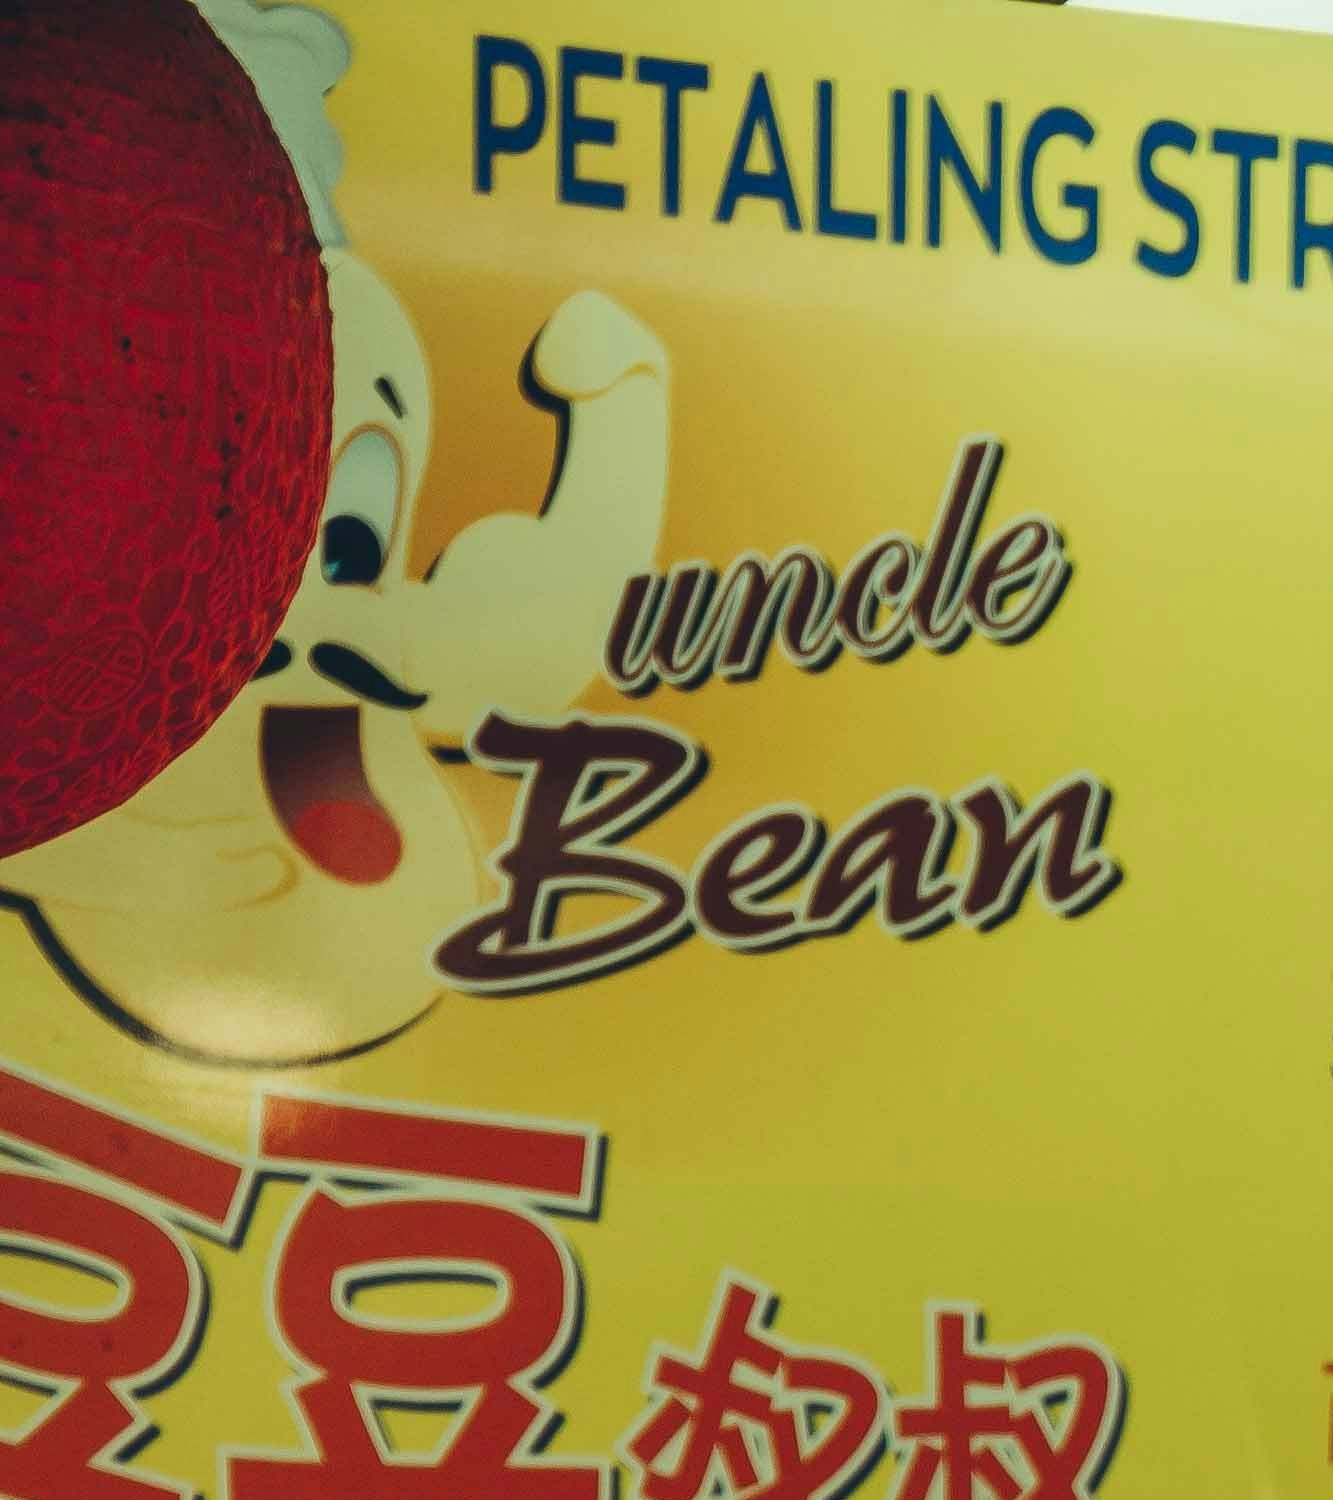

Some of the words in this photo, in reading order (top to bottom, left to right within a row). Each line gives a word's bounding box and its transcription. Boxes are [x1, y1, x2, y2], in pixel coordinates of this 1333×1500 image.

[471, 34, 1102, 268] PETALING
[603, 432, 1073, 700] uncle
[427, 706, 1124, 1000] Bean
